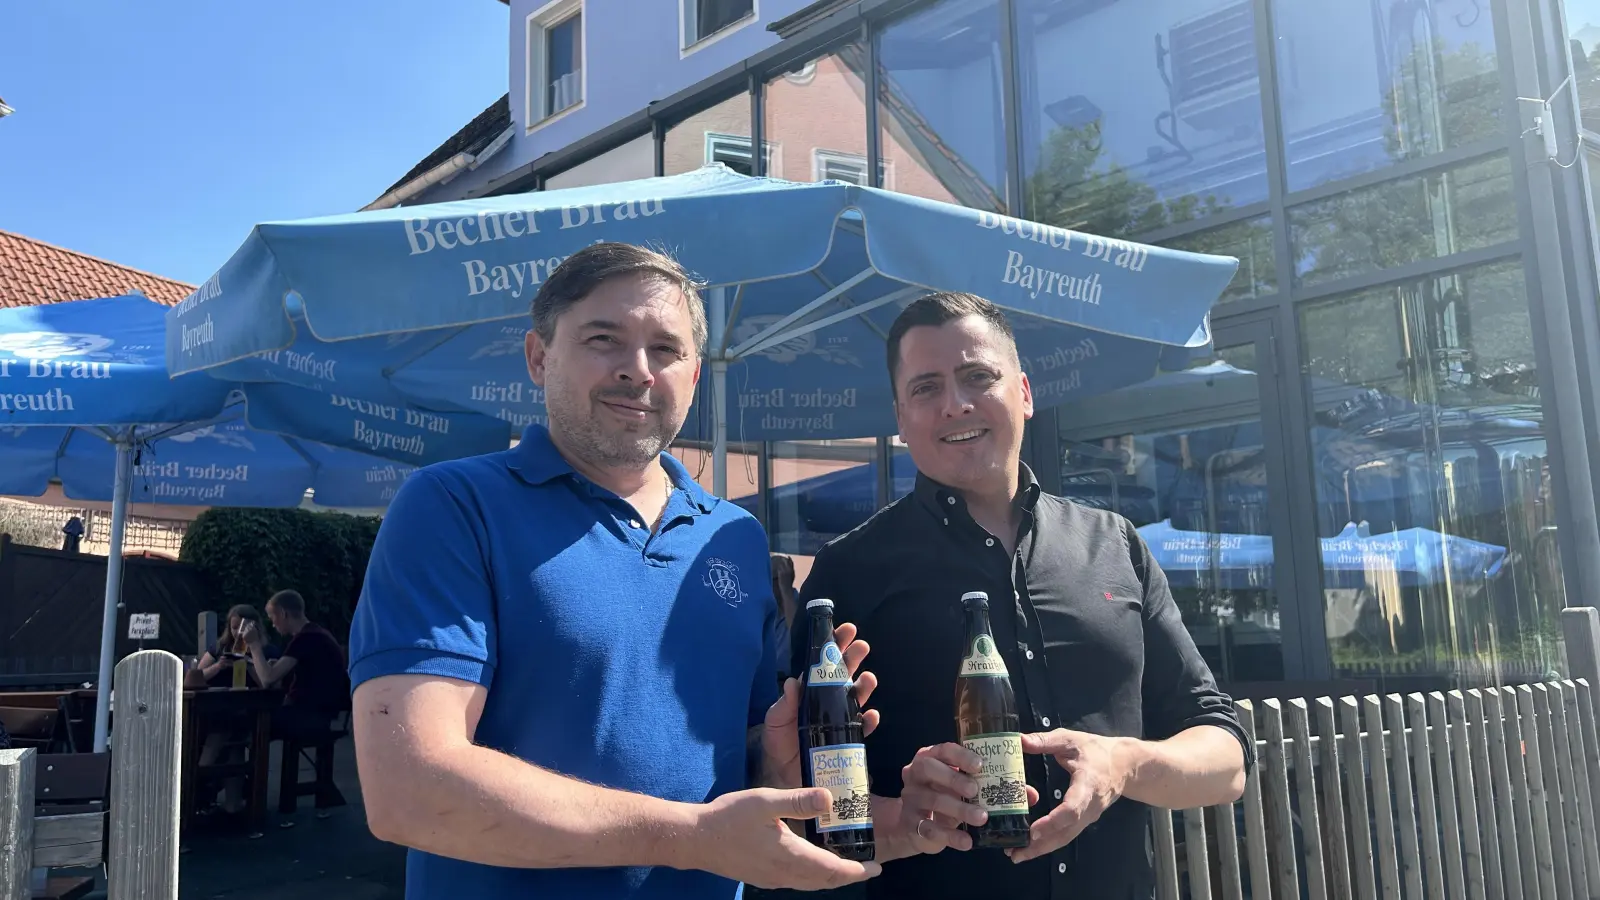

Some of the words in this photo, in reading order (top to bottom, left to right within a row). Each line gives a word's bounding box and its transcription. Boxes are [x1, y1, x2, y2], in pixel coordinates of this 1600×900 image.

[404, 209, 542, 256] Becher
[461, 256, 577, 298] Bayre
[1002, 250, 1103, 305] Bayreuth
[181, 312, 214, 357] Bayreuth
[0, 387, 75, 411] reuth
[354, 419, 425, 456] Bayreuth
[814, 752, 852, 771] Becher
[815, 775, 854, 788] Vollbier
